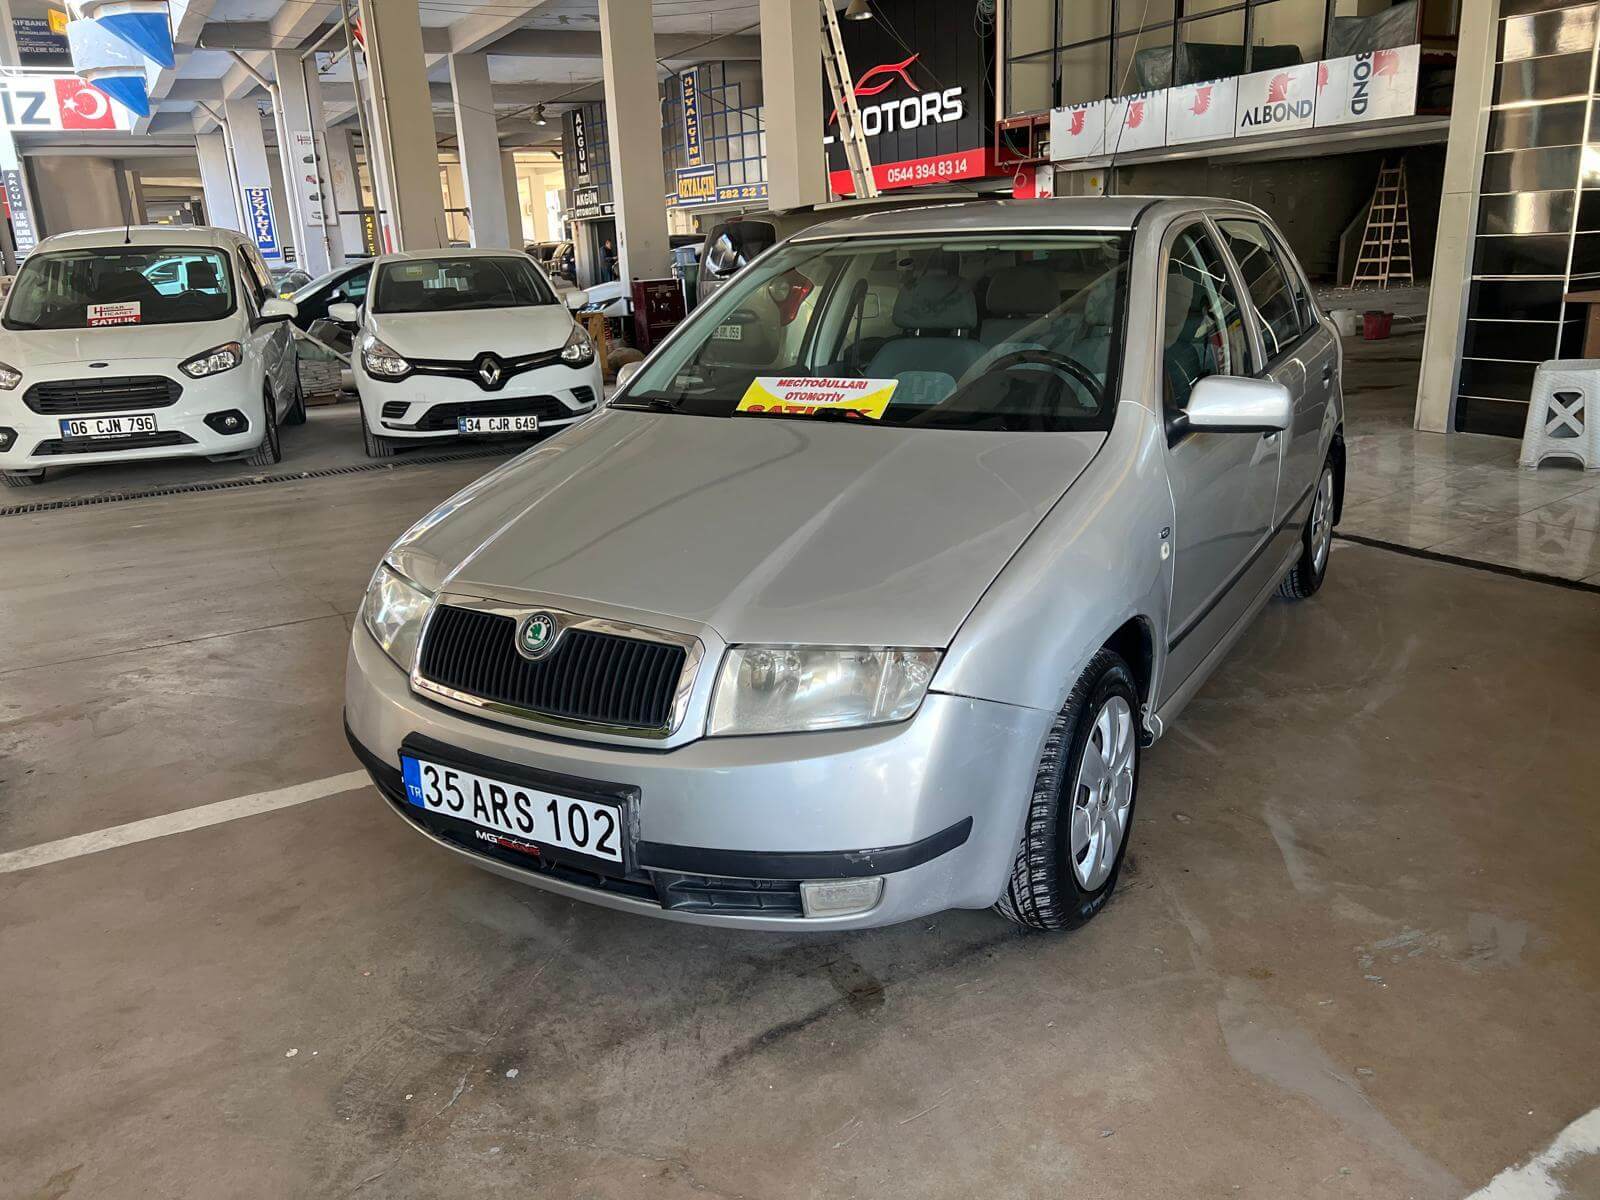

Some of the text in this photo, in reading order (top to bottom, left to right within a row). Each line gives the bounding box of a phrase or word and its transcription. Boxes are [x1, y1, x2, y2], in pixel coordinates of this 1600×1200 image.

[840, 86, 963, 142] OTORS
[1241, 99, 1313, 128] ALBOND
[575, 112, 588, 174] AKGÜN
[887, 157, 967, 183] 0544 394 83 14
[776, 378, 868, 390] MECİTOĞULLARI
[784, 391, 845, 403] OTOMOTİV
[71, 421, 88, 435] 06
[96, 418, 122, 434] CJN
[127, 416, 153, 431] 796
[467, 418, 481, 432] 34
[488, 418, 510, 431] CJR
[515, 417, 536, 430] 649
[408, 784, 422, 798] TR
[424, 765, 465, 812] 35
[473, 780, 534, 834] ARS
[547, 799, 617, 856] 102
